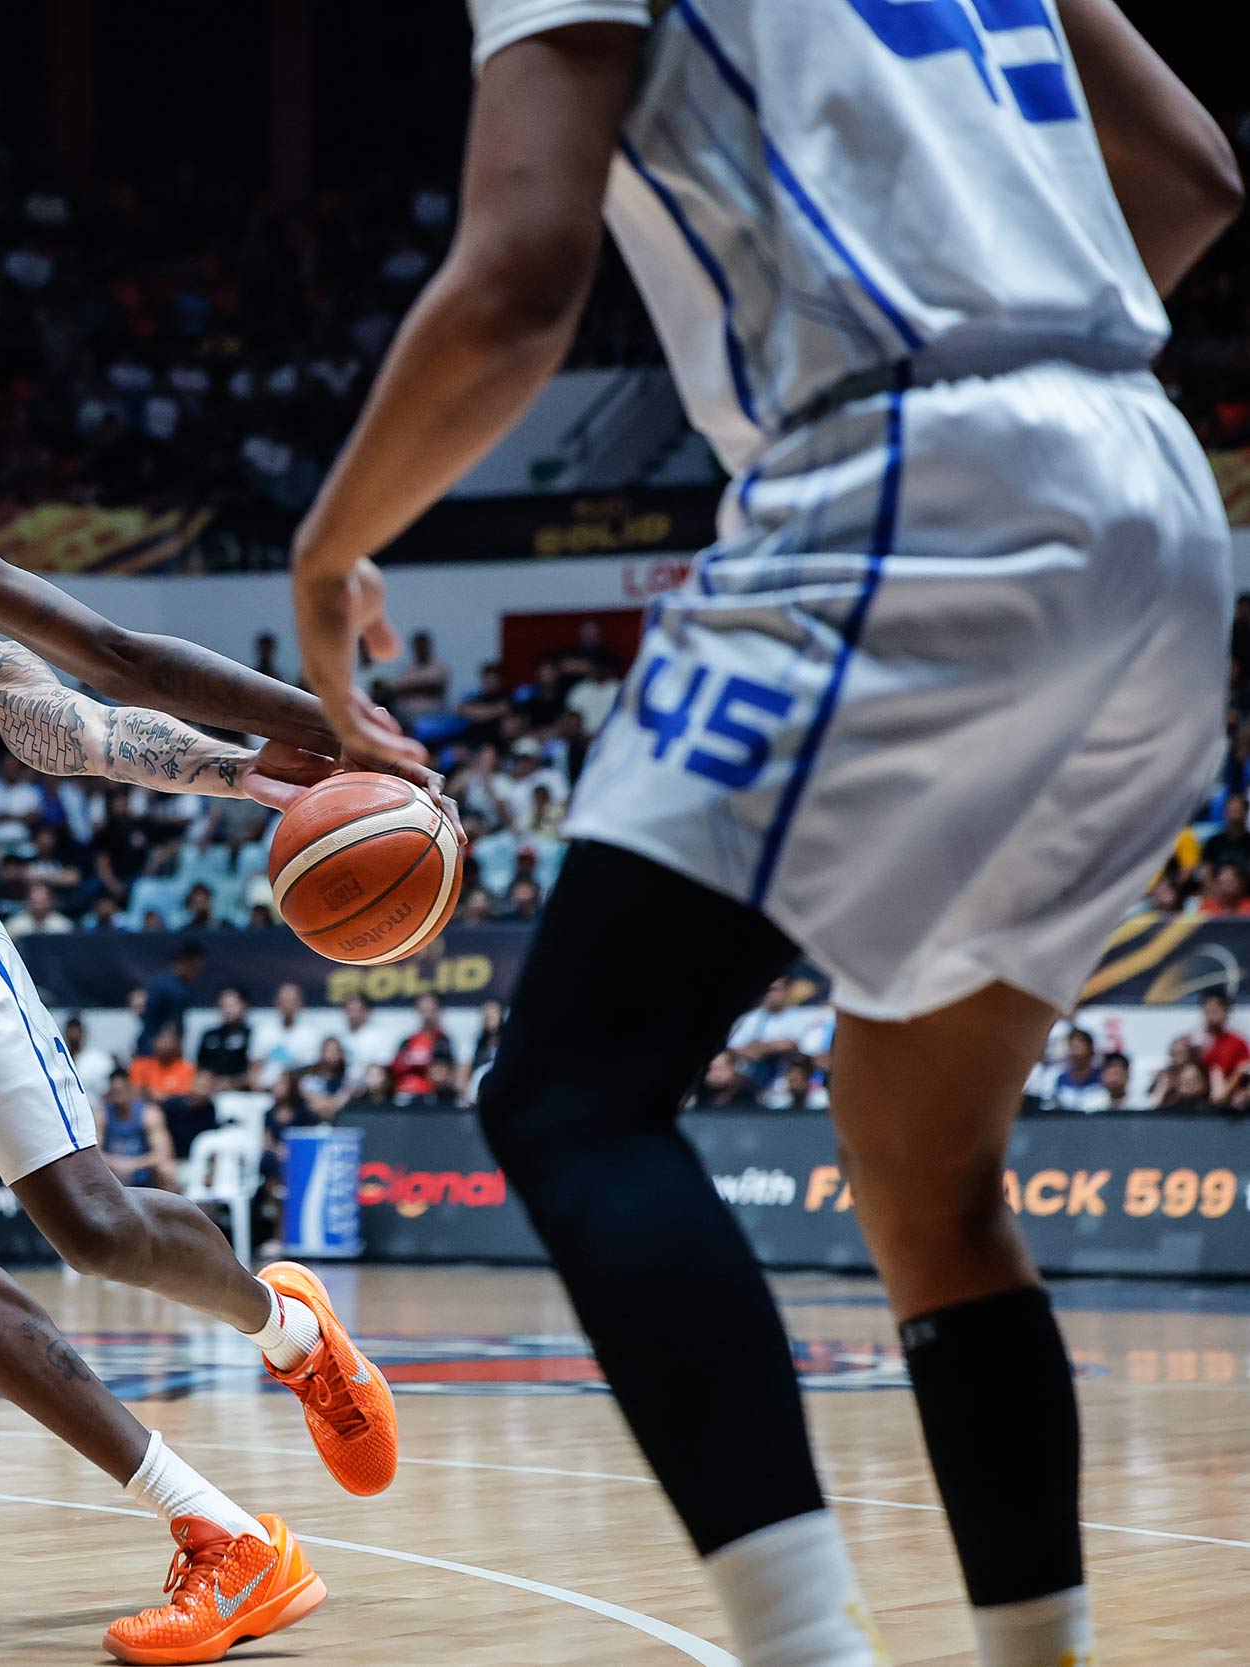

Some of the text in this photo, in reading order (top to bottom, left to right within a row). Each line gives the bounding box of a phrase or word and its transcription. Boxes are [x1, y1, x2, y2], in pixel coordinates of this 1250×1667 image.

[638, 656, 795, 788] 45
[337, 901, 414, 951] molten
[327, 953, 493, 1004] SOLID
[1122, 1167, 1238, 1219] 599
